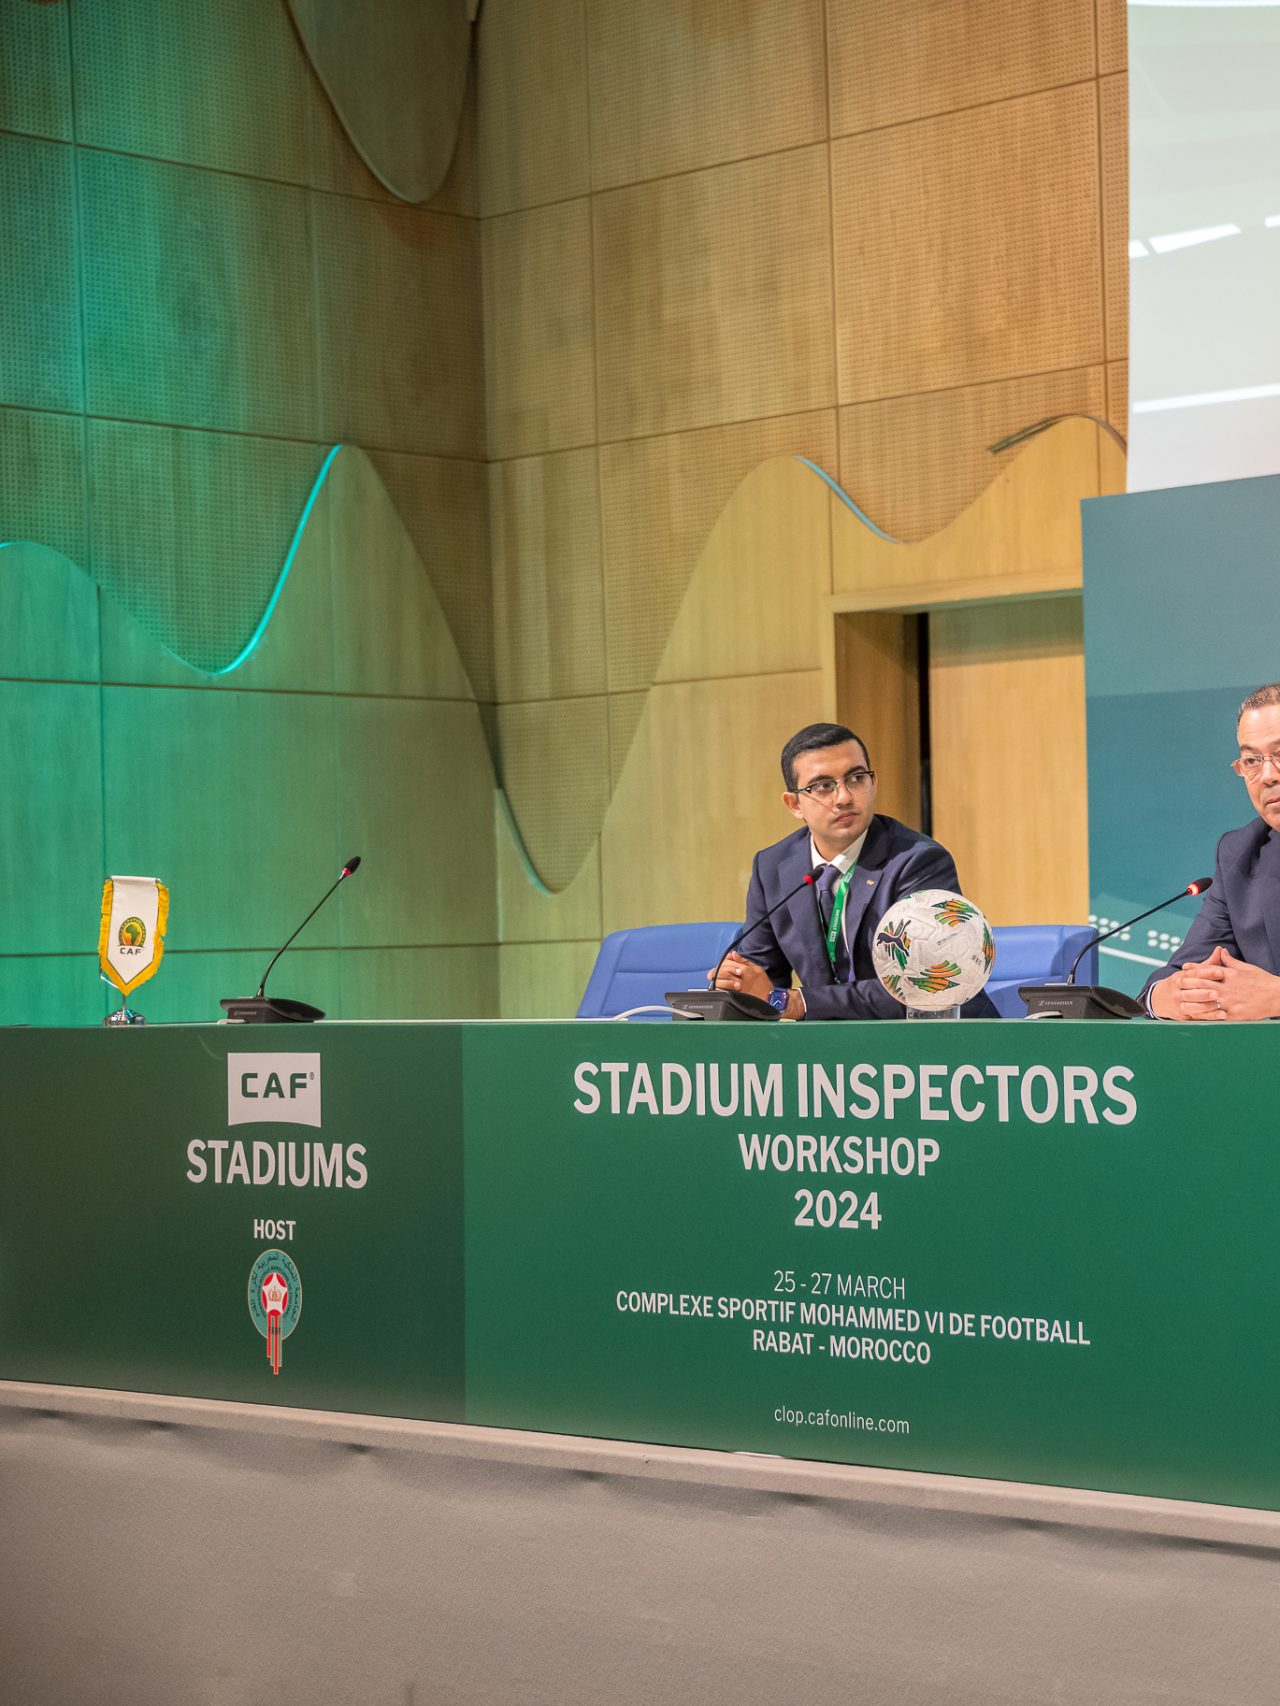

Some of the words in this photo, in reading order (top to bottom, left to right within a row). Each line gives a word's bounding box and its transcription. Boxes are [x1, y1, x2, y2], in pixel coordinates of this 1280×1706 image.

[119, 947, 142, 955] CAF
[573, 1061, 784, 1118] STADIUM
[798, 1063, 1138, 1126] INSPECTORS
[186, 1138, 368, 1189] STADIUMS
[737, 1133, 940, 1177] WORKSHOP
[794, 1188, 883, 1230] 2024
[253, 1218, 297, 1241] HOST
[773, 1270, 796, 1293] 25
[810, 1272, 832, 1295] 27
[837, 1273, 906, 1300] MARCH
[616, 1290, 714, 1318] COMPLEXE
[717, 1296, 796, 1323] SPORTIF
[800, 1302, 921, 1333] MOHAMMED
[924, 1310, 945, 1334] VI
[949, 1312, 976, 1337] DE
[980, 1314, 1091, 1345] FOOTBALL
[752, 1328, 815, 1355] RABAT
[829, 1335, 932, 1365] MOROCCO
[773, 1405, 911, 1434] clop.cafonline.com
